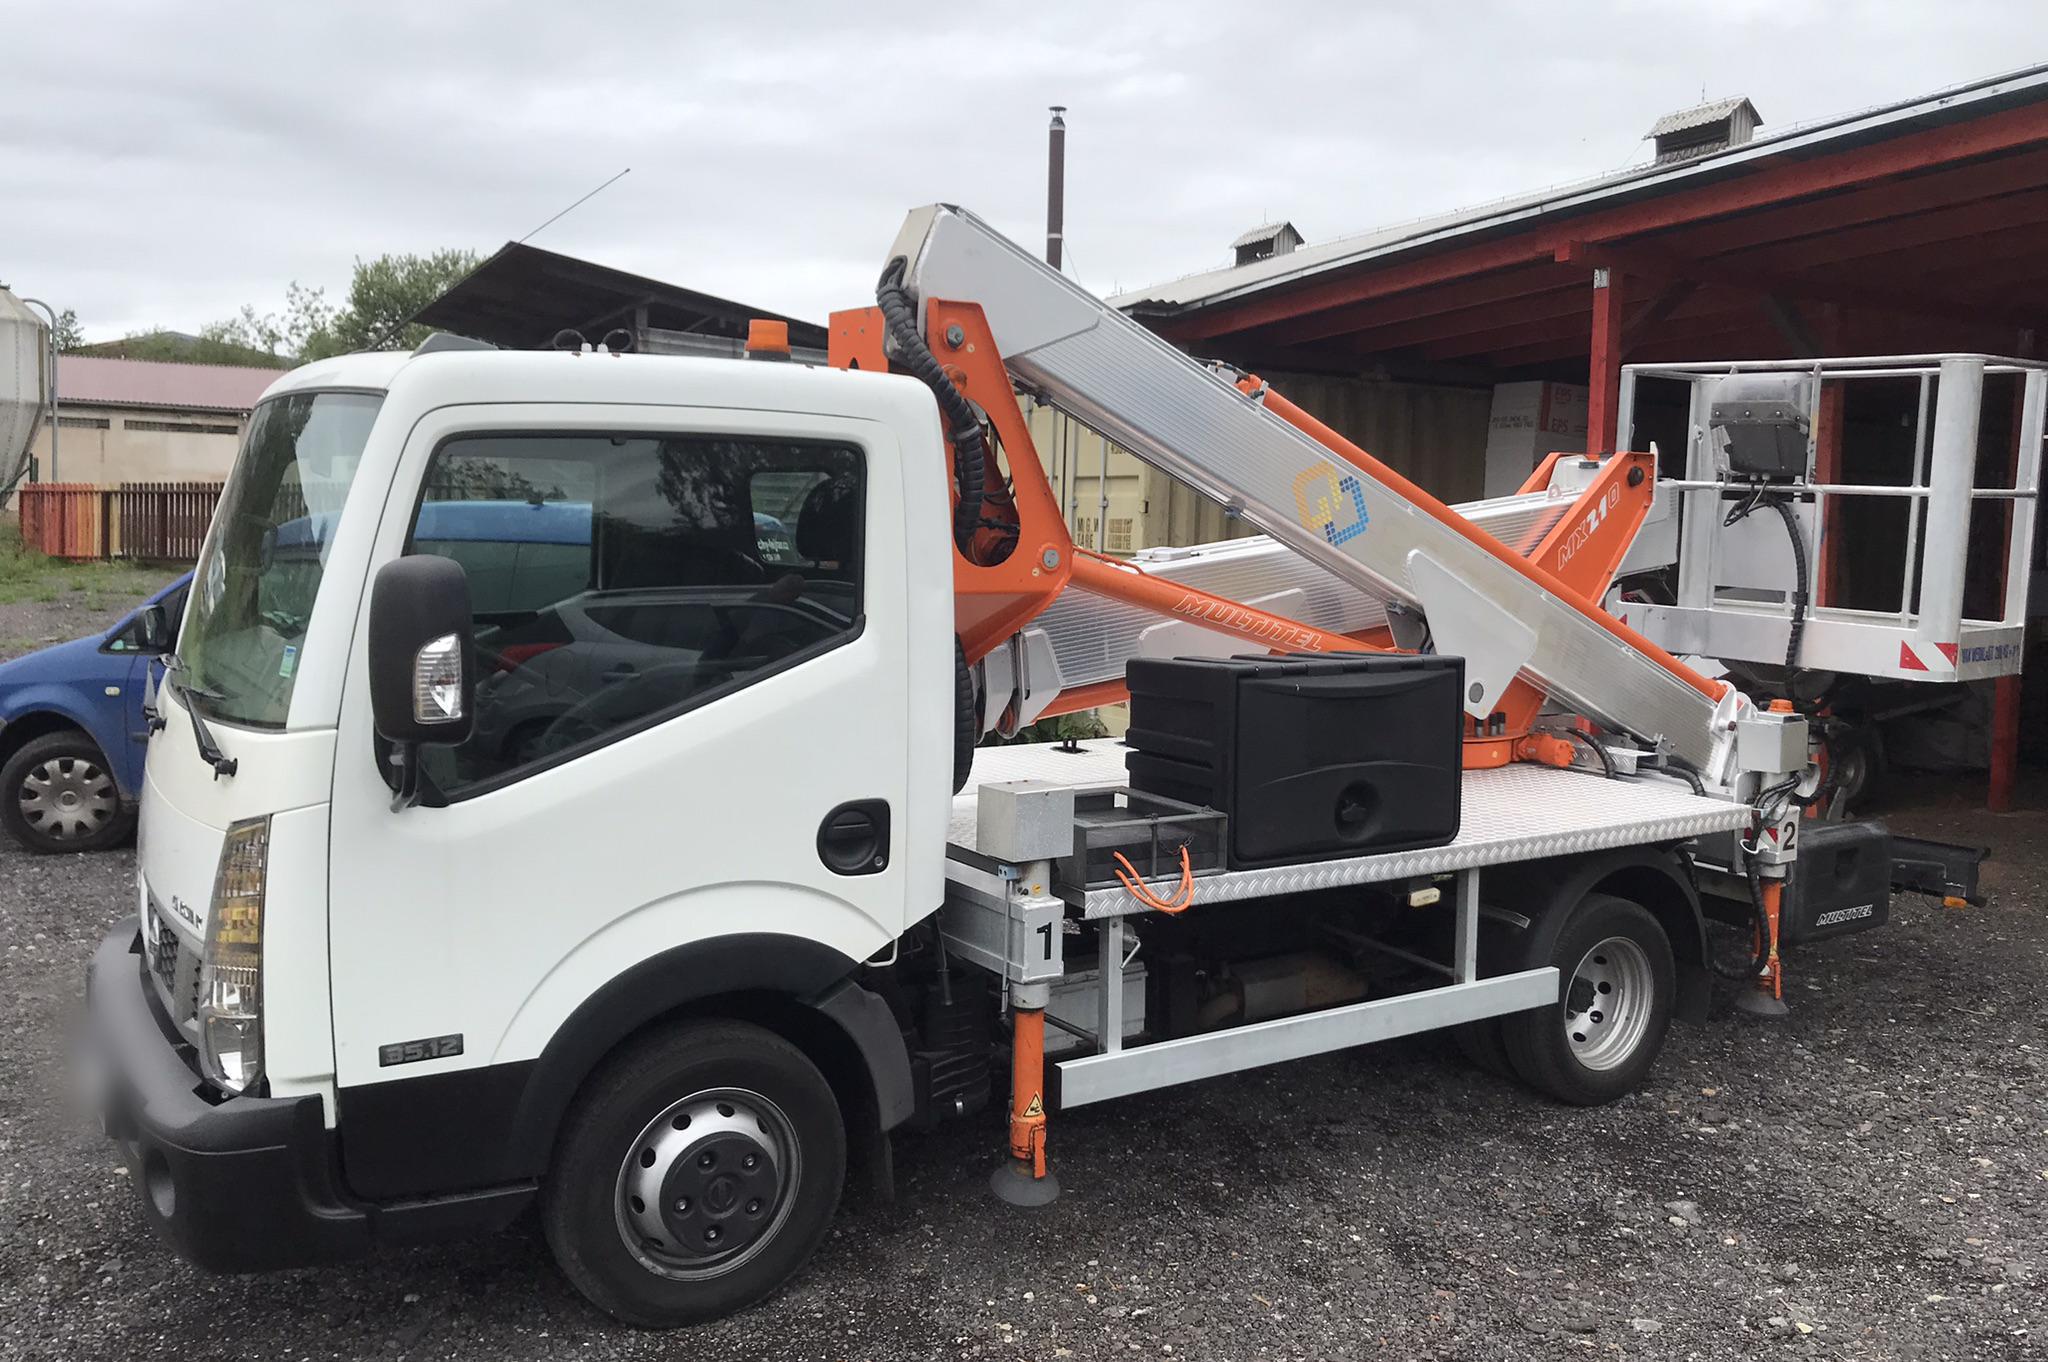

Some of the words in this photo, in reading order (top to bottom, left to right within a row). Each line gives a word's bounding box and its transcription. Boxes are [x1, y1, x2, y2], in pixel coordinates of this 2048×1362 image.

[1551, 416, 1569, 433] EPS
[1557, 481, 1620, 572] MX210
[1172, 592, 1323, 653] MULTITEL
[1782, 821, 1796, 851] 2
[1815, 903, 1874, 927] MULTITEL
[1036, 921, 1053, 961] 1
